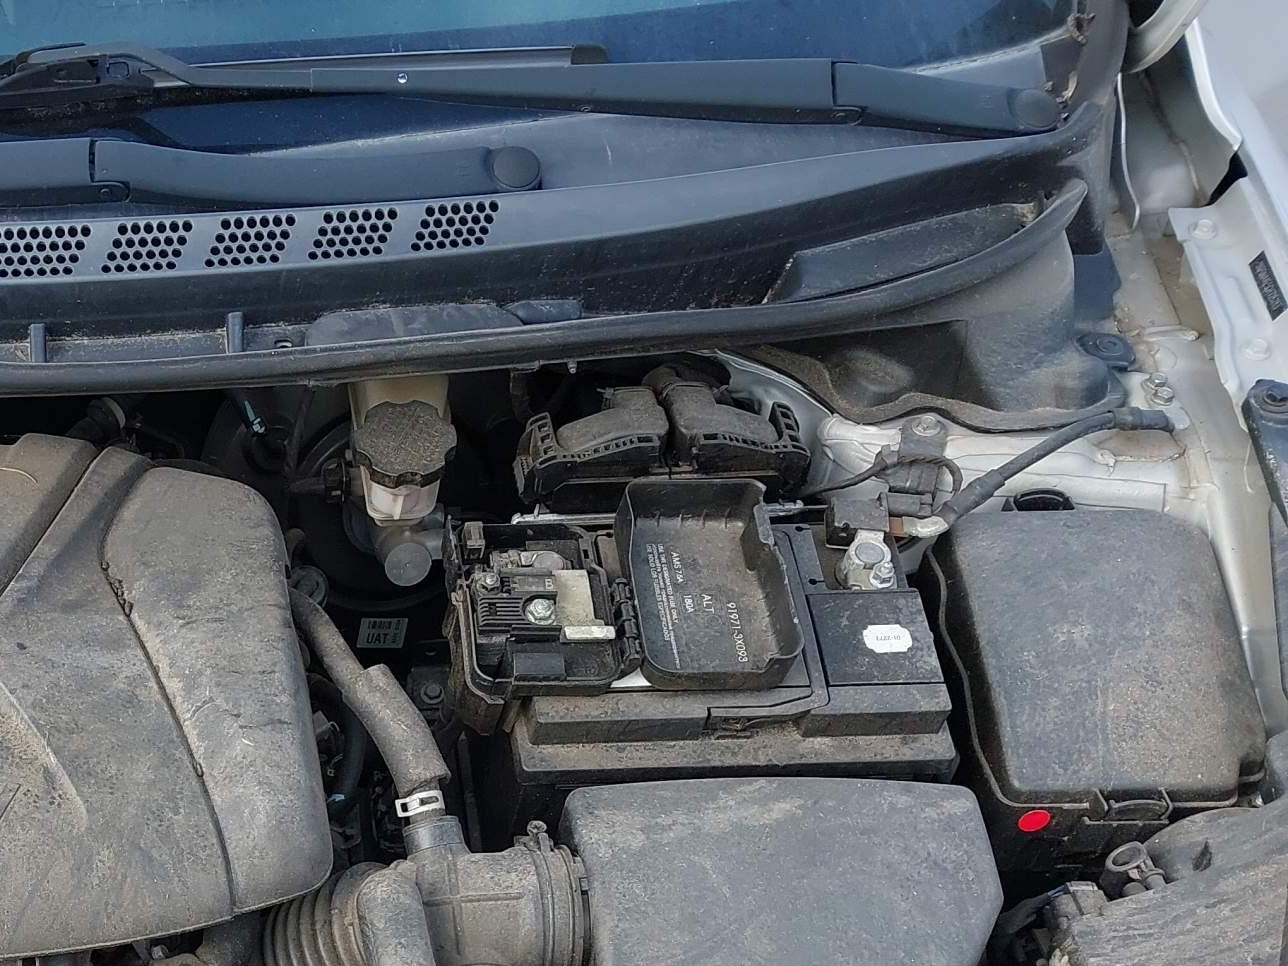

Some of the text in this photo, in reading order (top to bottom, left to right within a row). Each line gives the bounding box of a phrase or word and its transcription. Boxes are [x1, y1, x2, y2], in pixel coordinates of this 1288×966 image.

[670, 551, 682, 569] AMS
[683, 594, 695, 614] 180A
[701, 593, 715, 614] ALT
[366, 632, 390, 644] UAT
[726, 601, 748, 663] 91971-3X093
